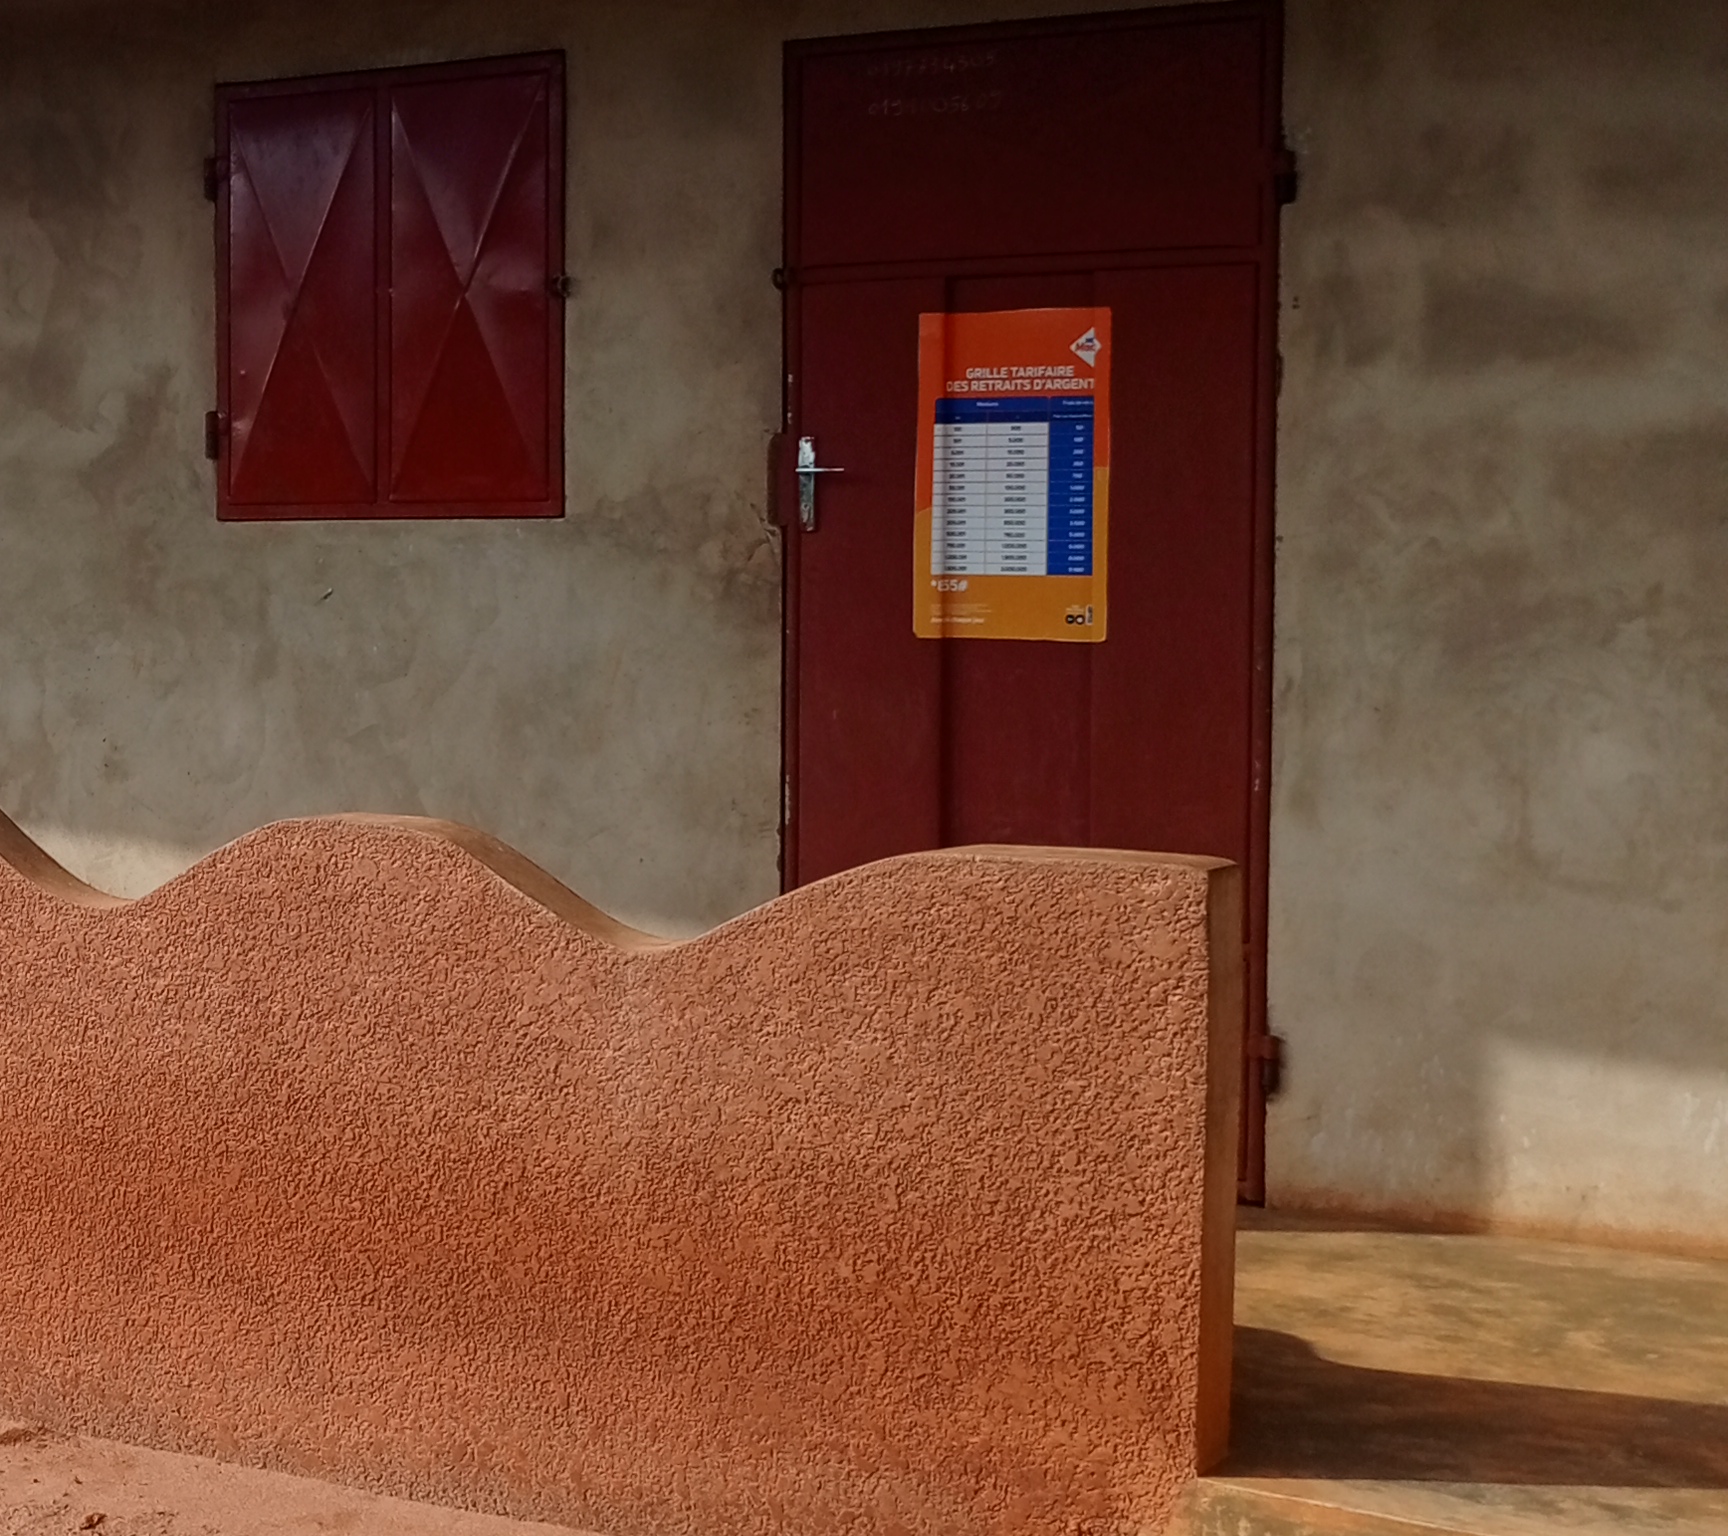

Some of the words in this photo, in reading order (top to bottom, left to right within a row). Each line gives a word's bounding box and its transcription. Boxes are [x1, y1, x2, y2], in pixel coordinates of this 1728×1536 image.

[965, 366, 1008, 379] GRILLE
[1010, 365, 1075, 378] TARIFAIRE
[946, 380, 969, 393] DES
[970, 379, 1031, 392] RETRAITS
[1033, 378, 1095, 390] D'ARGENT
